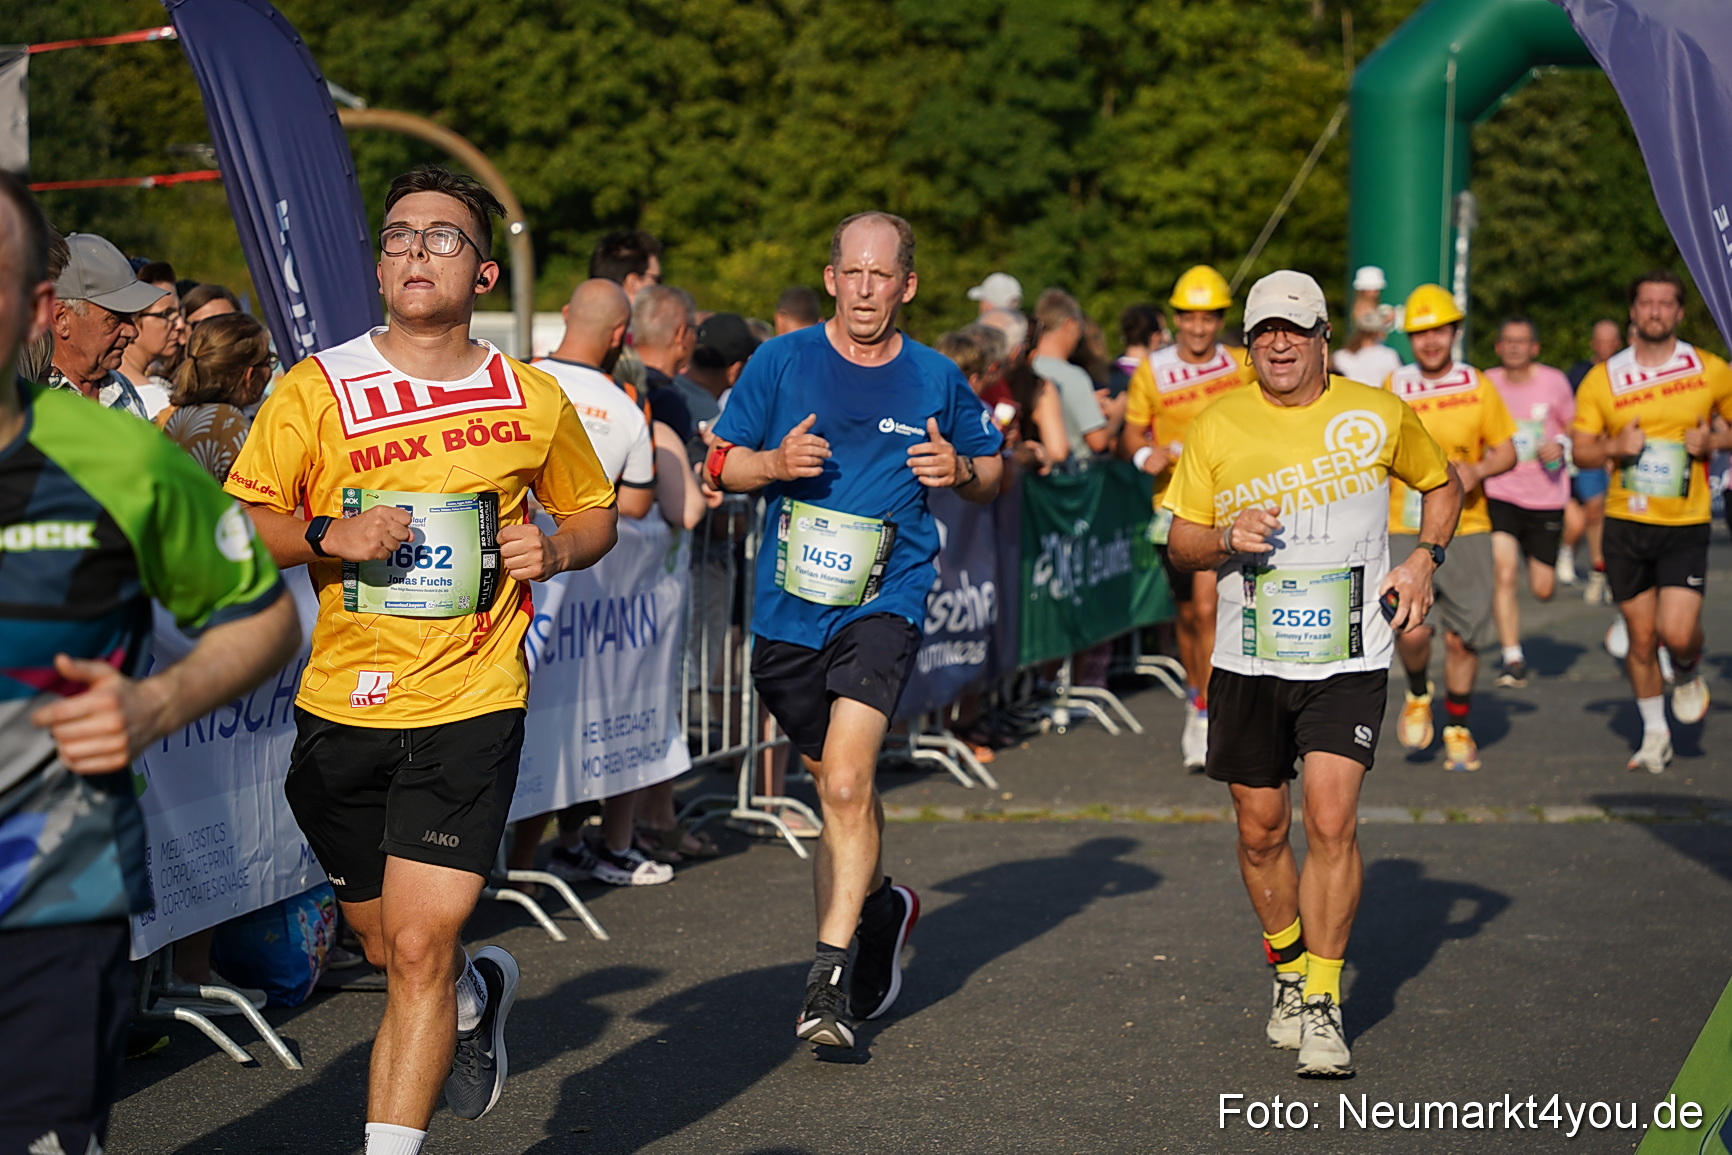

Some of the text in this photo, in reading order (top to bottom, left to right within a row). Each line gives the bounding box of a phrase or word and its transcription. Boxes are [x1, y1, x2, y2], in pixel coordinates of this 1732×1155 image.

[349, 418, 531, 473] MAX BÖGL
[1213, 450, 1356, 517] SPANGLER
[343, 497, 359, 505] AOK
[0, 520, 98, 552] OCK
[802, 544, 853, 572] 1453
[387, 574, 453, 587] Jonas Fuchs
[480, 571, 492, 606] HILTL
[1271, 608, 1332, 627] 2526
[1275, 631, 1302, 641] Jimmy
[421, 829, 460, 848] JAKO
[160, 845, 235, 889] CORPORATE PRINT
[161, 867, 250, 916] CORPORATE SIGNAGE
